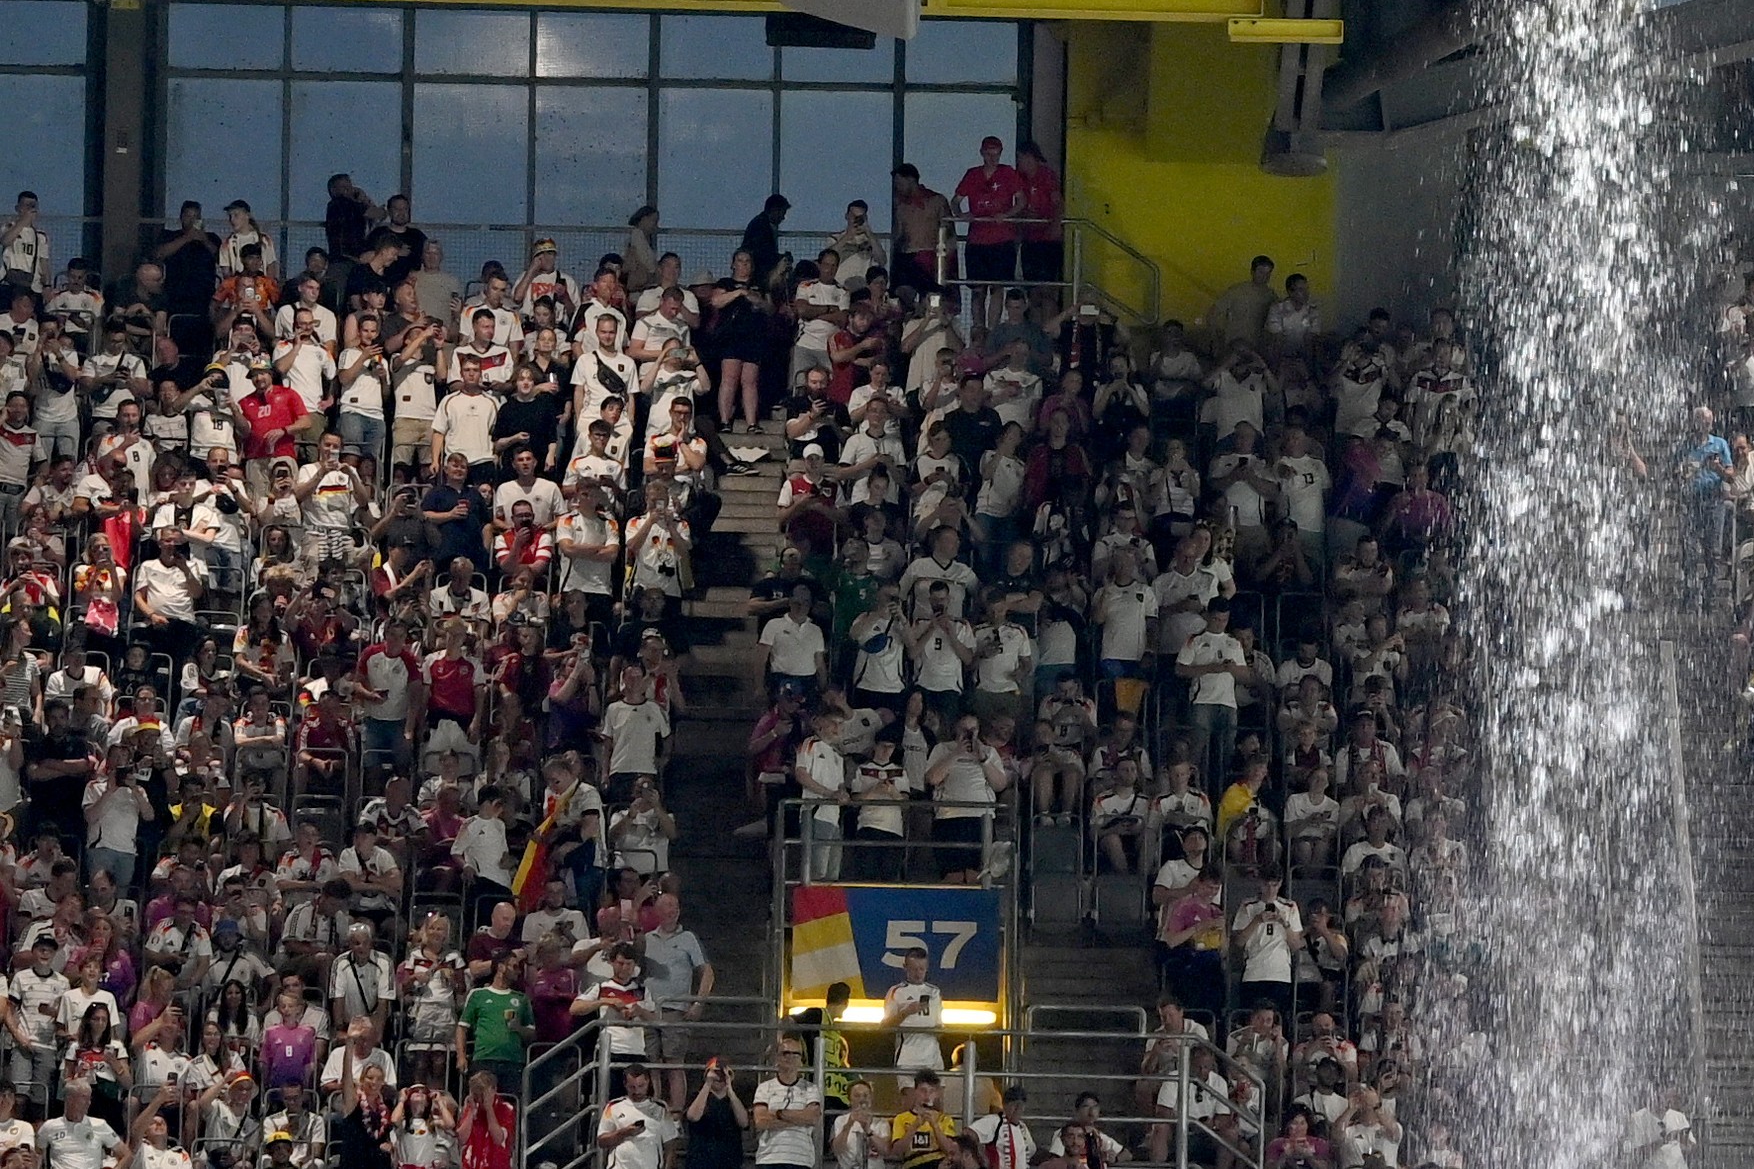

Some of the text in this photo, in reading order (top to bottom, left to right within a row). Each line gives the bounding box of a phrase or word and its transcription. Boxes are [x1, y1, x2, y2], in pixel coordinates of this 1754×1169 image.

[22, 243, 33, 255] 10
[258, 406, 271, 418] 20
[132, 451, 140, 462] 8
[1266, 923, 1274, 935] 8
[881, 920, 977, 969] 57
[285, 1045, 293, 1057] 8
[54, 1131, 66, 1141] 10
[914, 1134, 929, 1145] 1&1
